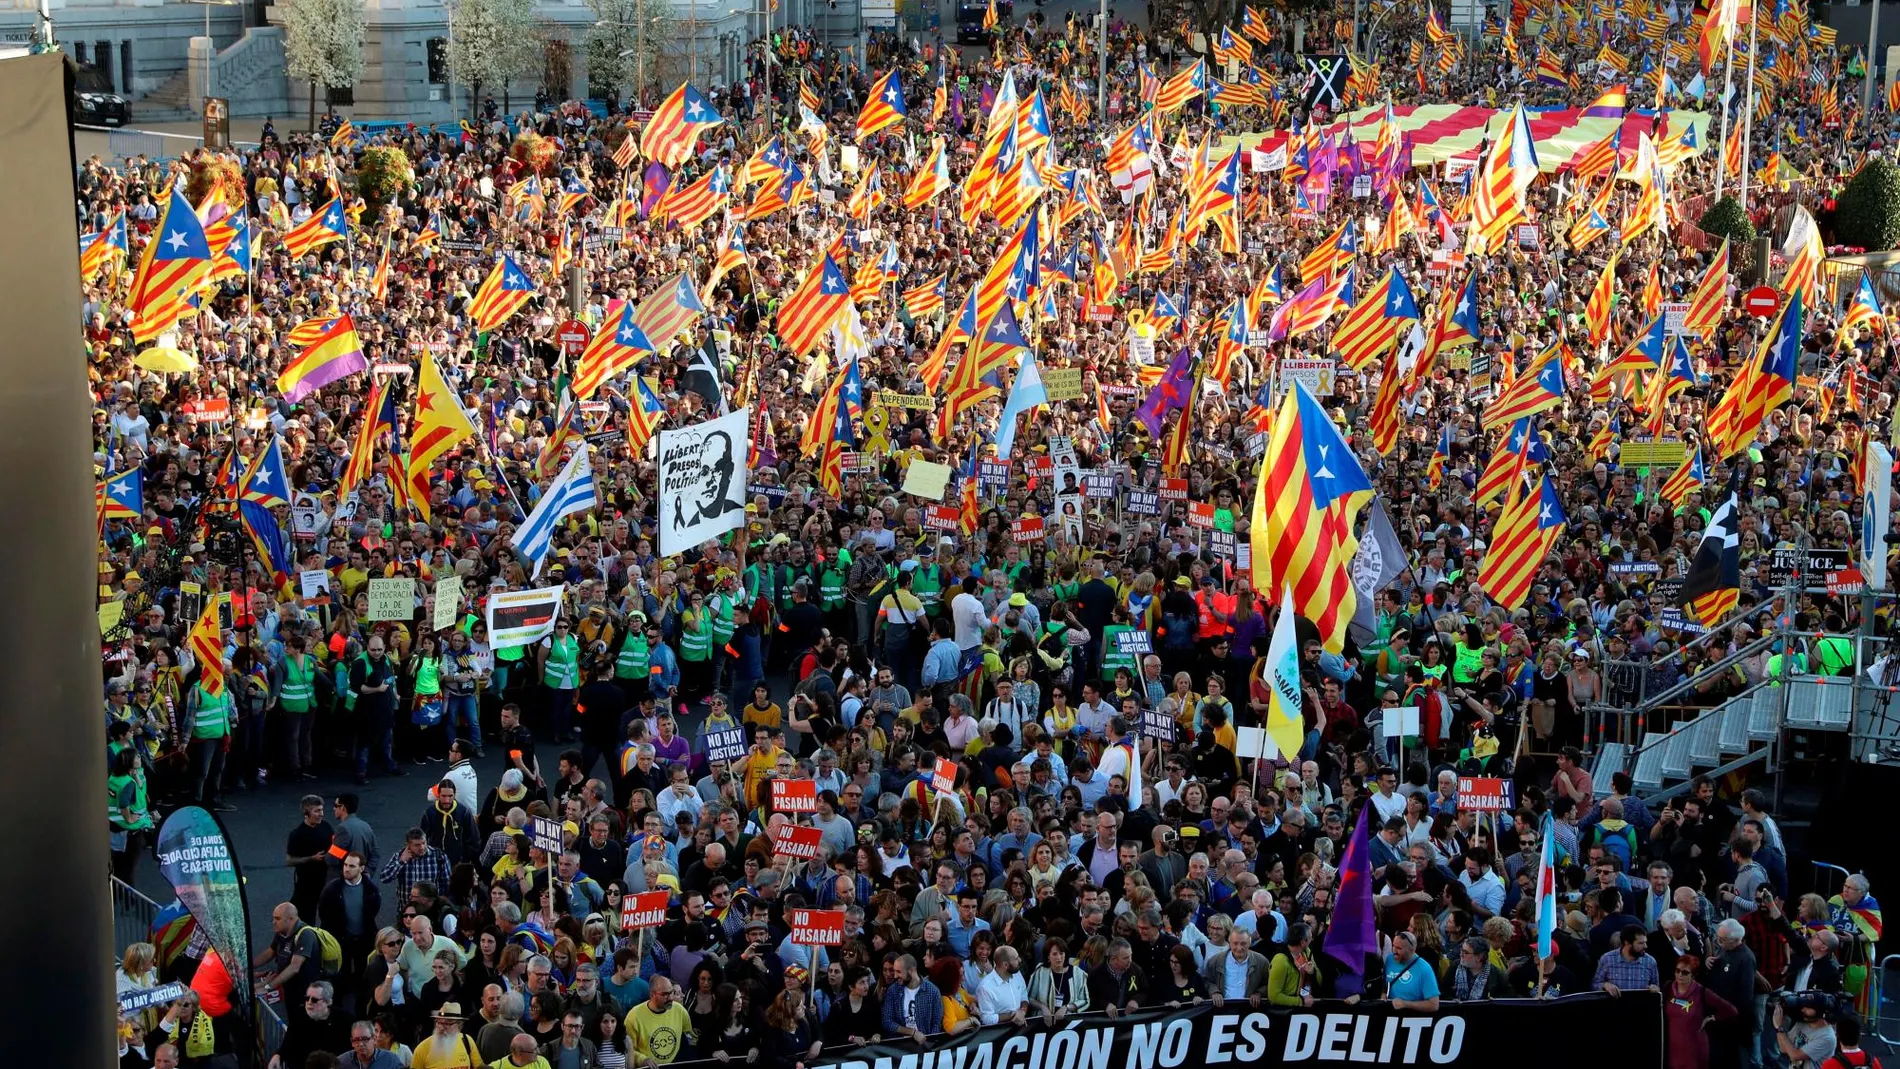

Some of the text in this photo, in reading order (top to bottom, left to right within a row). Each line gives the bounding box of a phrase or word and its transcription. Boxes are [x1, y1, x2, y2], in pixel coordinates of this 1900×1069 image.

[197, 403, 205, 412] NO
[197, 412, 225, 421] PASARÁN
[668, 459, 700, 476] PRESOS
[982, 464, 1007, 475] NO HAY
[1088, 476, 1113, 488] NO HAY
[1160, 479, 1168, 488] NO
[1086, 487, 1112, 497] JUSTÍCIA
[1131, 492, 1158, 505] NO HAY
[1160, 489, 1188, 499] PASARÁN
[928, 505, 938, 515] NO
[1128, 504, 1155, 514] JUSTÍCIA
[1189, 502, 1197, 511] NO
[927, 515, 957, 529] PASARÁN
[1012, 521, 1021, 531] NO
[1189, 512, 1214, 527] PASARÁN
[1013, 528, 1044, 542] PASARÁN
[1212, 531, 1234, 544] NO HAY
[1211, 543, 1234, 555] JUSTÍCIA
[1826, 574, 1837, 583] NO
[372, 582, 410, 590] ESTO VA DE
[1828, 581, 1863, 593] PASARÁN
[393, 601, 402, 609] DE
[1671, 621, 1684, 629] HAY
[1118, 631, 1147, 643] NO HAY
[1120, 642, 1150, 653] JUSTÍCIA
[1274, 668, 1302, 710] CANARI
[1144, 711, 1171, 729] NO HAY
[707, 729, 742, 748] NO HAY
[1143, 725, 1172, 740] JUSTÍCIA
[708, 744, 745, 761] JUSTÍCIA
[773, 781, 785, 795] NO
[932, 774, 954, 793] PASARÁN
[1460, 779, 1472, 793] NO
[774, 794, 815, 811] PASARÁN
[1459, 792, 1500, 808] PASARÁN
[535, 818, 561, 840] NO HAY
[779, 826, 794, 839] NO
[534, 835, 561, 854] JUSTÍCIA
[774, 840, 816, 858] PASARÁN
[624, 896, 637, 911] NO
[622, 907, 665, 927] PASARÁN
[794, 911, 809, 925] NO
[793, 926, 841, 943] PASARÁN
[121, 985, 183, 1010] NO HAY JUSTÍCIA
[1125, 1018, 1192, 1069] NO
[1205, 1012, 1270, 1064] ES
[1282, 1013, 1466, 1064] DELITO
